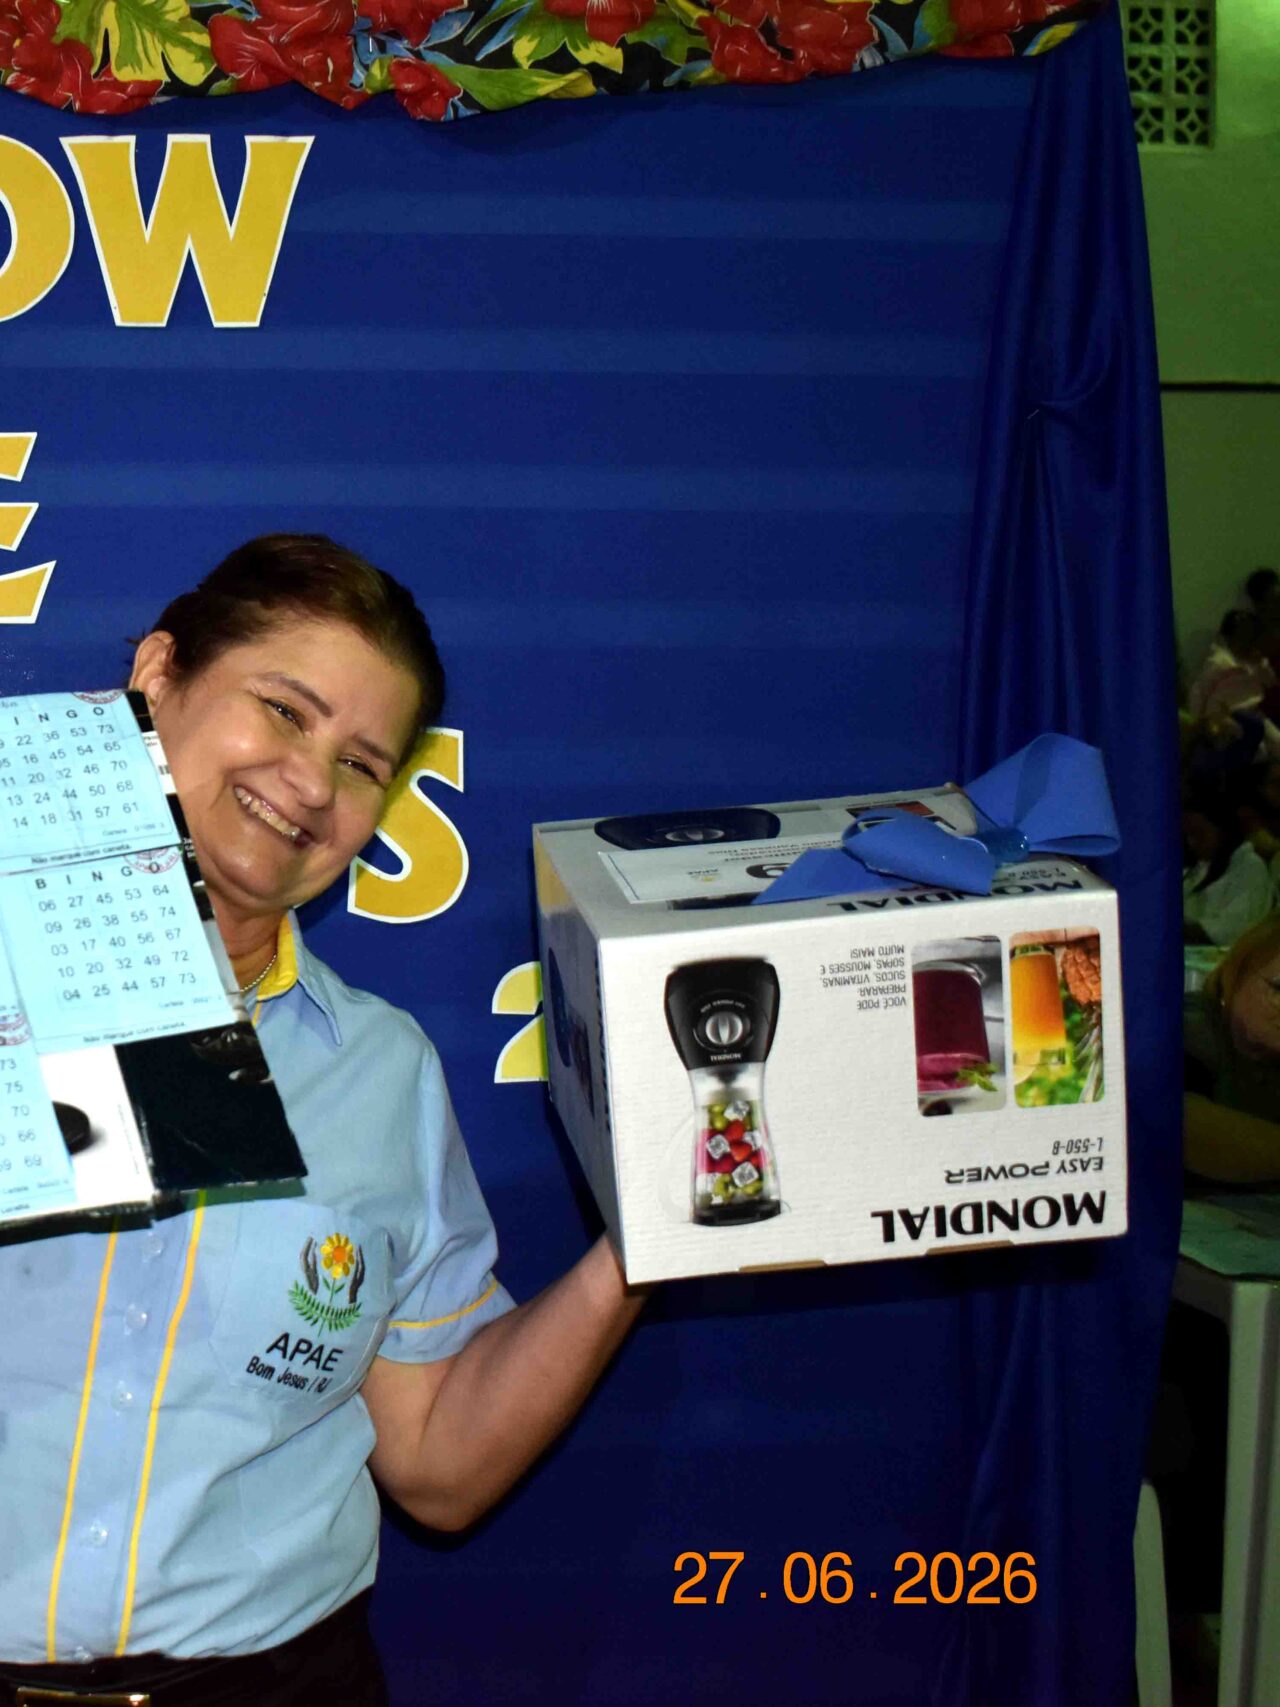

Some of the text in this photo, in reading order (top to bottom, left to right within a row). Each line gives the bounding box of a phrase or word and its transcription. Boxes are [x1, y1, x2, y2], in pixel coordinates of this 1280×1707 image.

[15, 734, 33, 747] 22
[67, 894, 84, 909] 27
[44, 920, 64, 935] 09
[159, 905, 177, 918] 74
[878, 945, 904, 956] MUITO
[820, 964, 826, 975] E
[829, 961, 871, 974] MOUSSES
[857, 999, 880, 1010] PODE
[944, 1156, 1103, 1184] EASY POWER
[870, 1190, 1106, 1243] MONDIAL
[265, 1332, 344, 1372] APAE
[246, 1355, 275, 1380] Bom
[277, 1366, 309, 1389] Jesus
